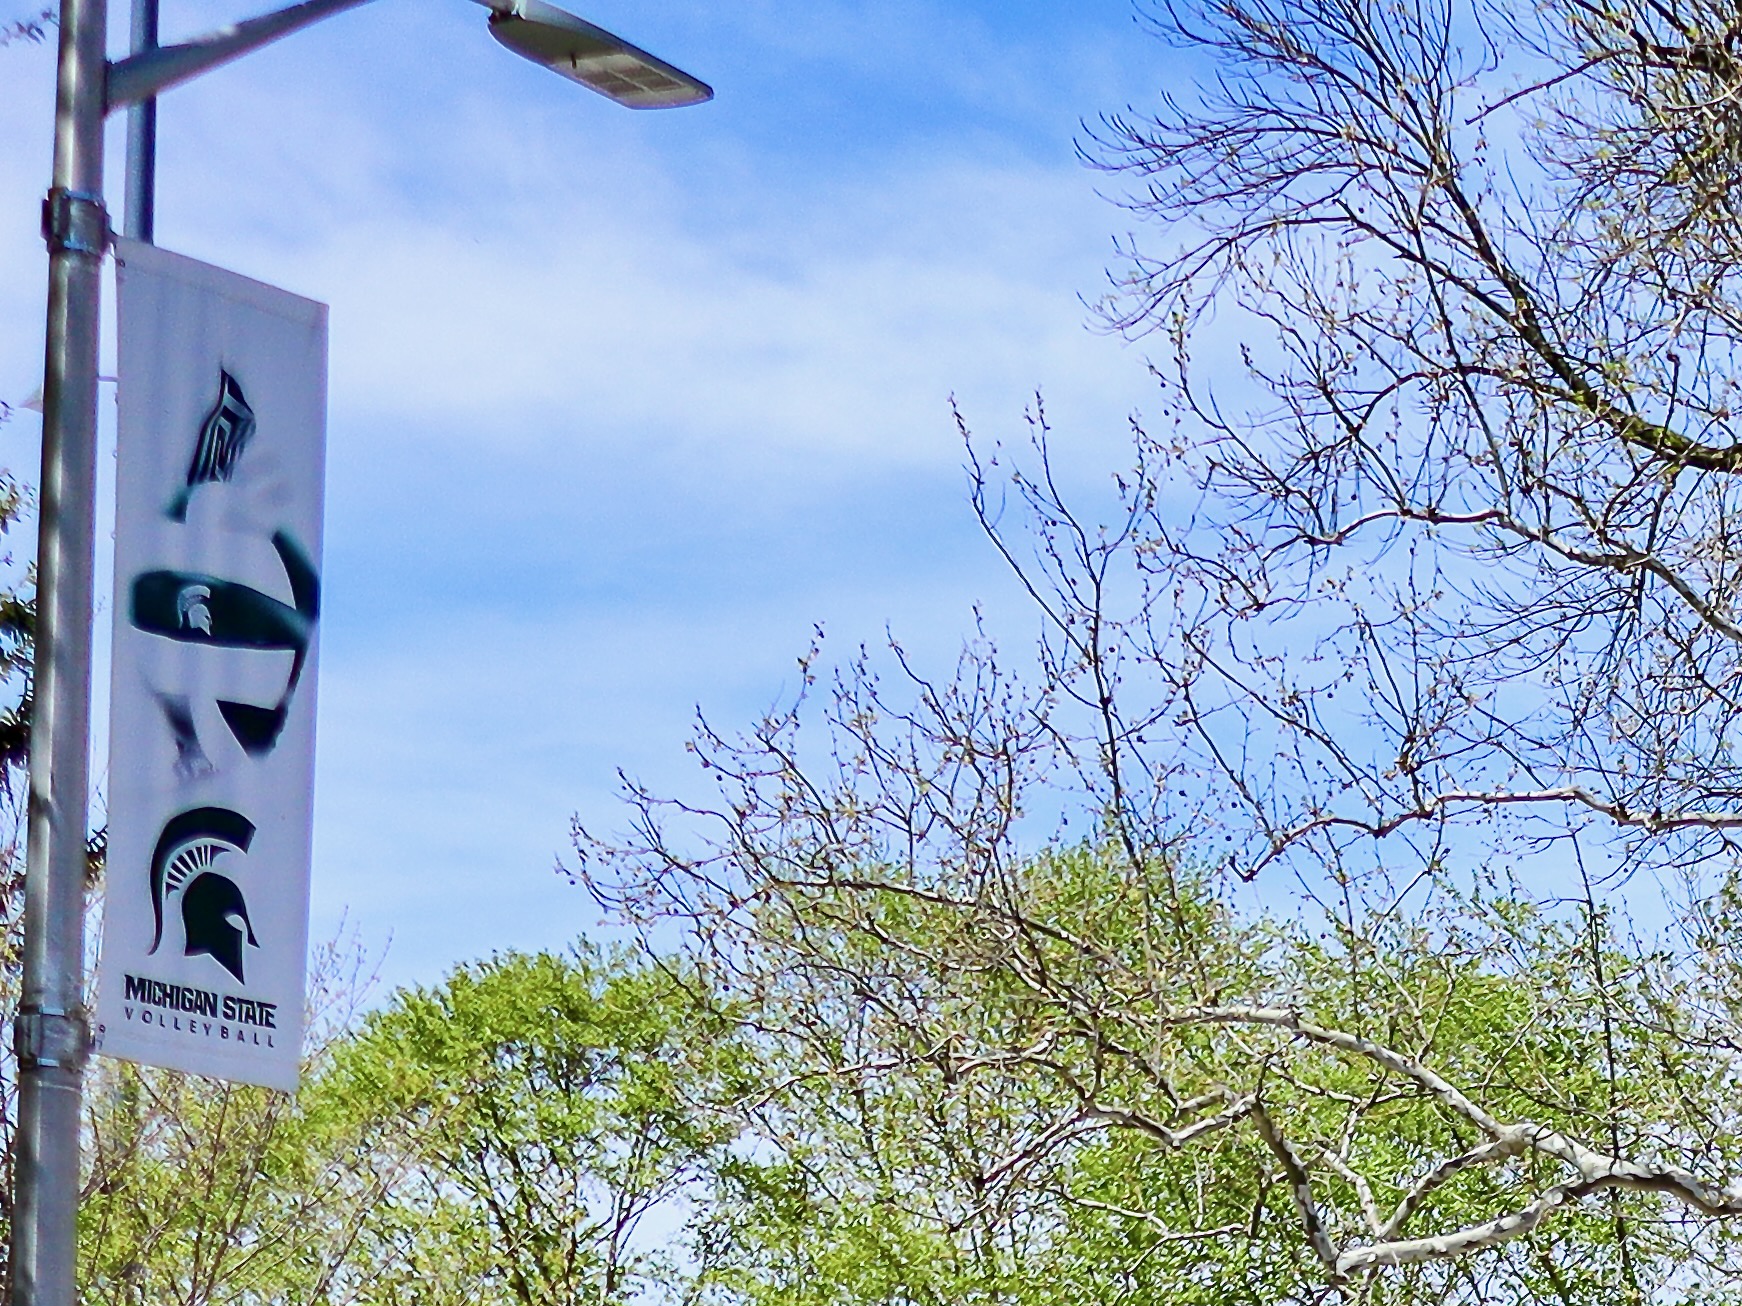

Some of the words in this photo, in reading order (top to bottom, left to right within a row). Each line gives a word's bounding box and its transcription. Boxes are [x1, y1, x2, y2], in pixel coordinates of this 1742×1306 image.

[124, 974, 218, 1018] MICHIGAN
[222, 996, 277, 1029] STATE
[124, 1006, 275, 1048] VOLLEYBALL
